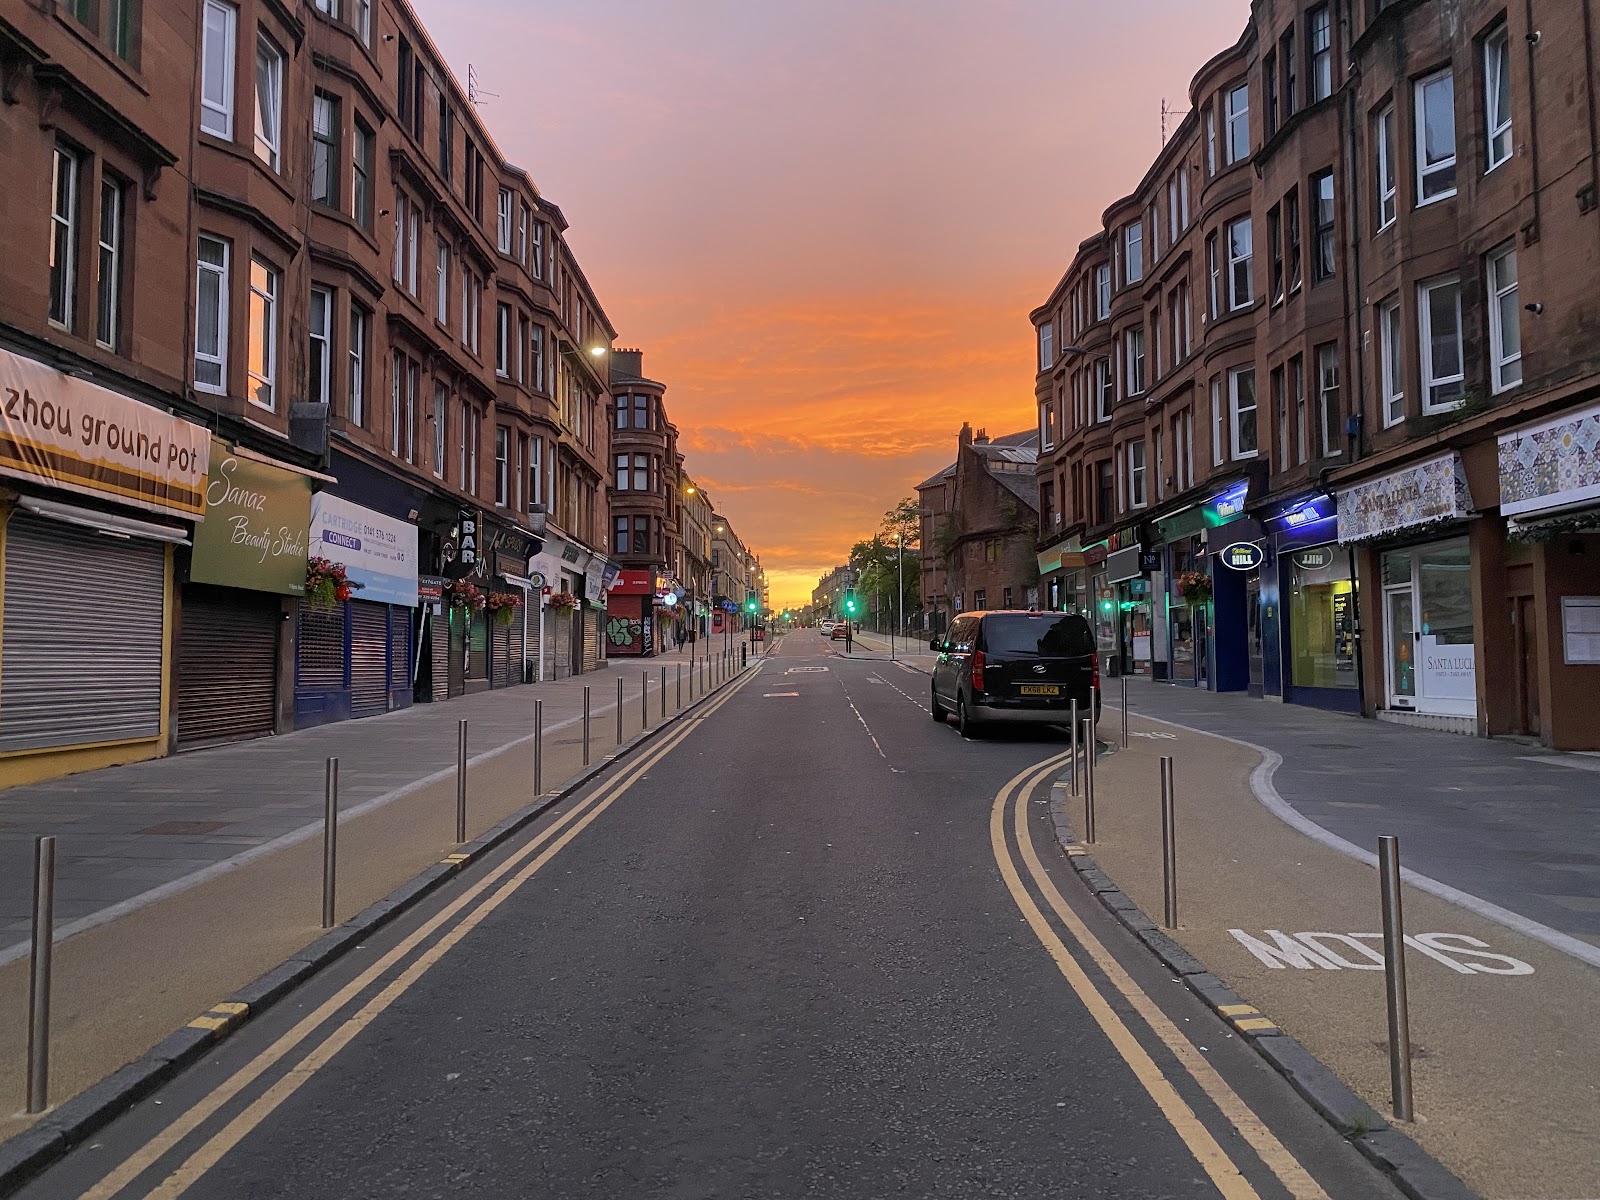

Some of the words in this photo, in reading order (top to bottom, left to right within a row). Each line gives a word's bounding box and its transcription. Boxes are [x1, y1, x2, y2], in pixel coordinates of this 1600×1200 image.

[0, 387, 72, 437] zhou
[81, 414, 162, 464] ground
[167, 443, 197, 475] pot
[206, 457, 267, 512] Sanaz
[228, 515, 271, 564] Beauty
[271, 526, 304, 557] Studio
[322, 511, 362, 535] CARTRIDGE
[328, 531, 357, 549] CONNECT
[461, 520, 475, 563] BAR
[1231, 554, 1253, 565] HILL
[1226, 928, 1536, 976] SLOW
